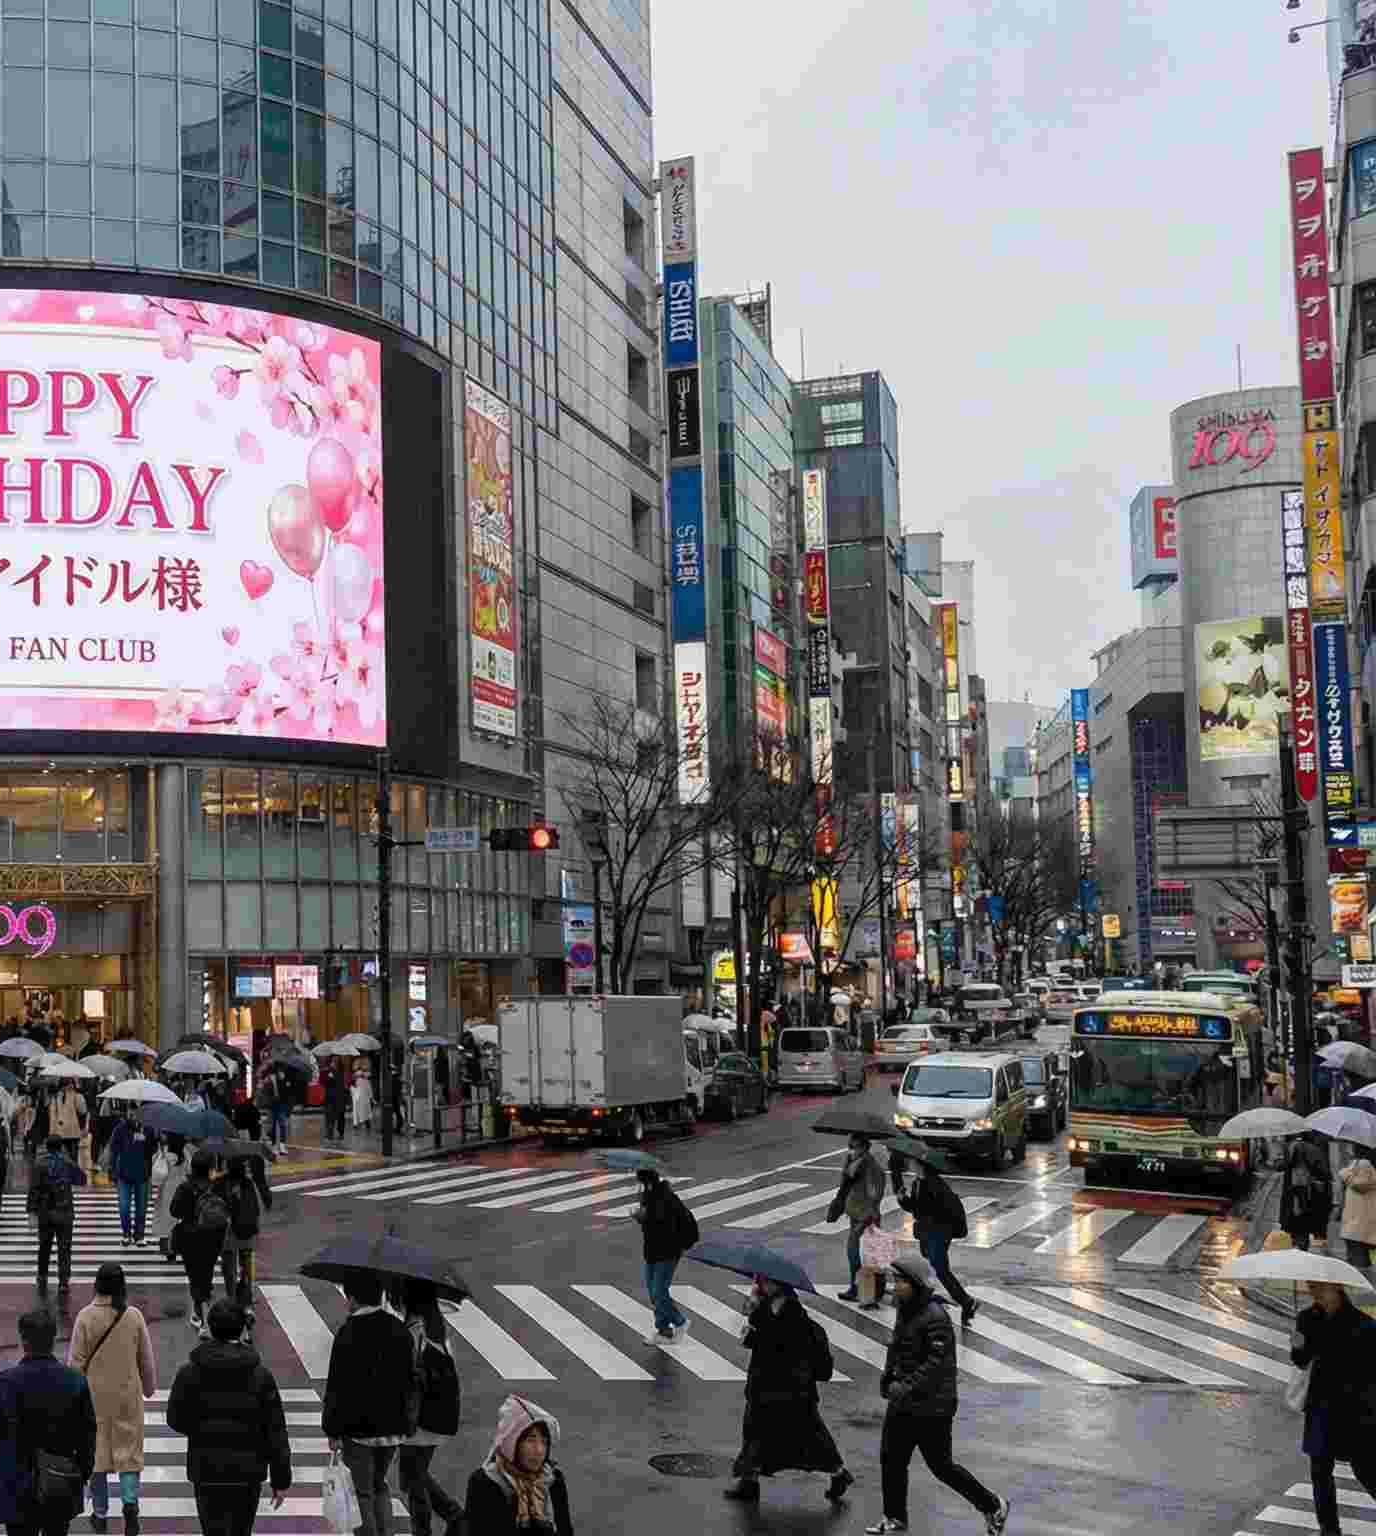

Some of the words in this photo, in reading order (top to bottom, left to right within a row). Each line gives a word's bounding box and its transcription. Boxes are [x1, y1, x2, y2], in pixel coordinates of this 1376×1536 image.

[1187, 421, 1277, 474] 109
[9, 636, 68, 662] FAN
[78, 637, 156, 663] CLUB
